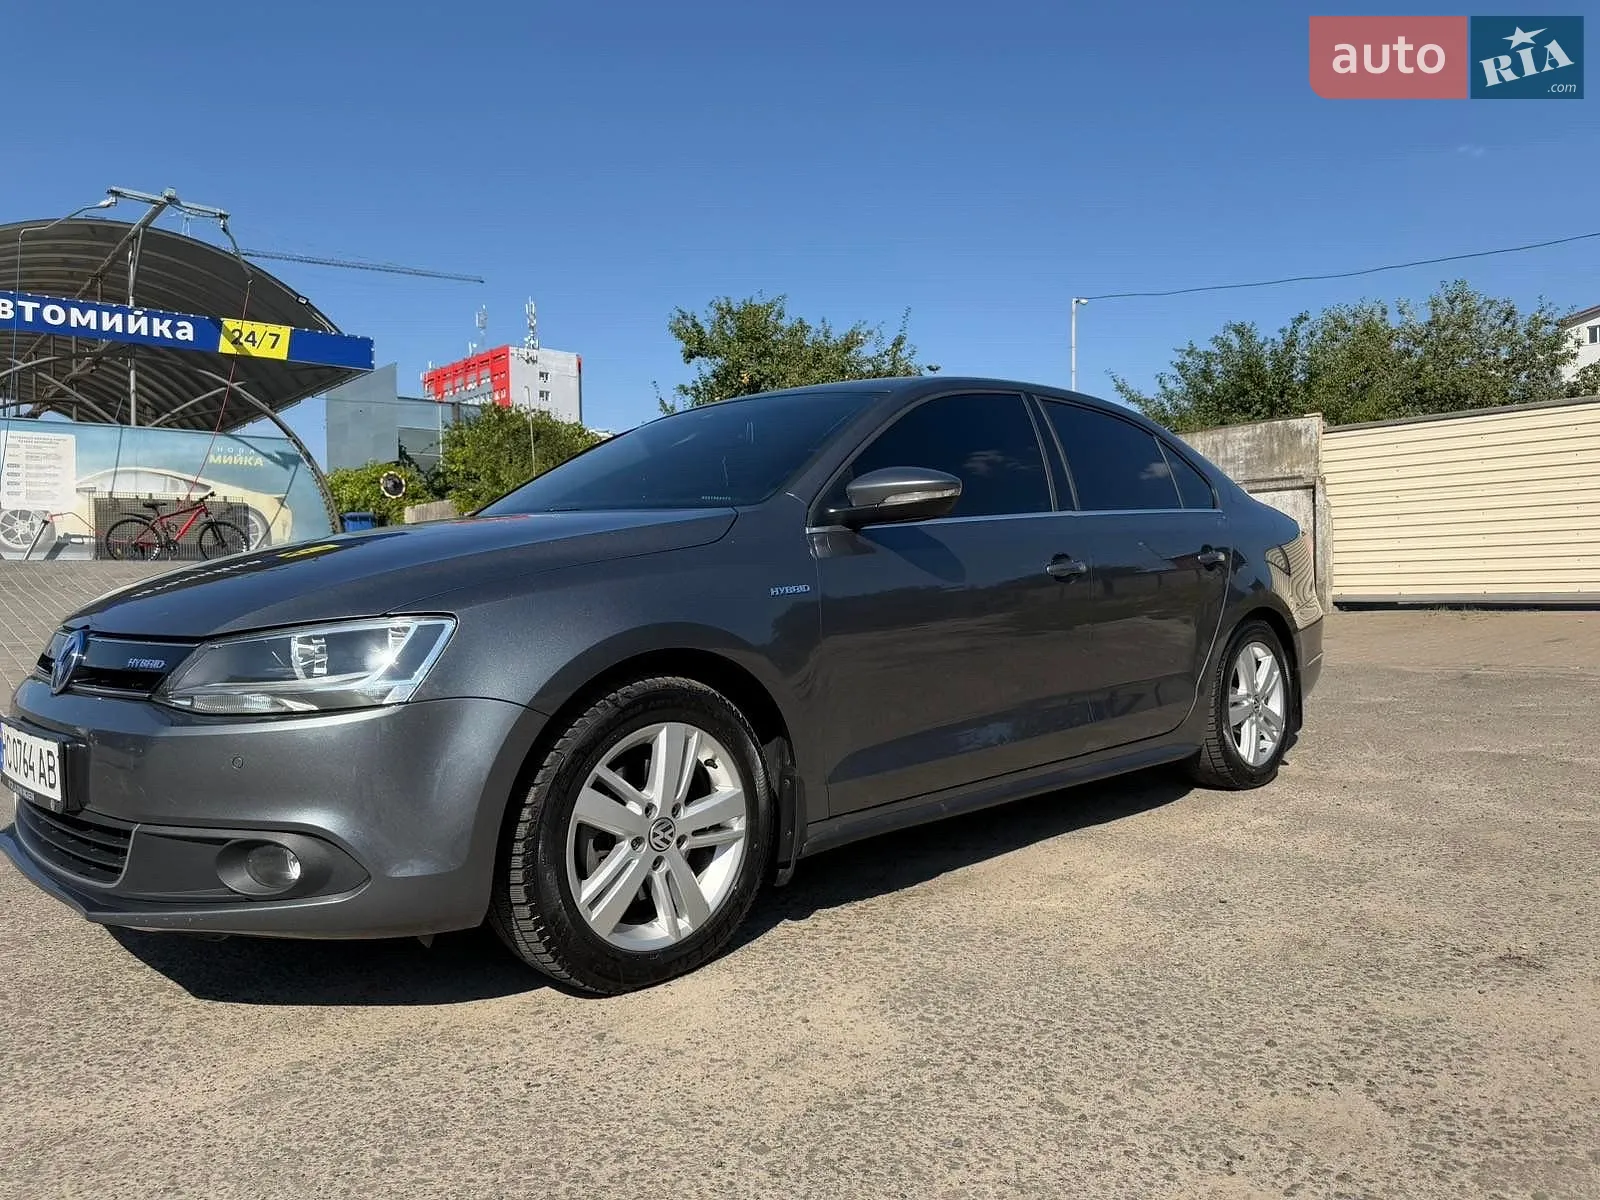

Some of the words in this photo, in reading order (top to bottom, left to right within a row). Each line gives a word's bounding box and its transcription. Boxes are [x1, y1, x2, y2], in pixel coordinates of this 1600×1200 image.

[230, 328, 281, 350] 24/7
[769, 584, 811, 596] HYBRID
[127, 658, 165, 669] HYBRID
